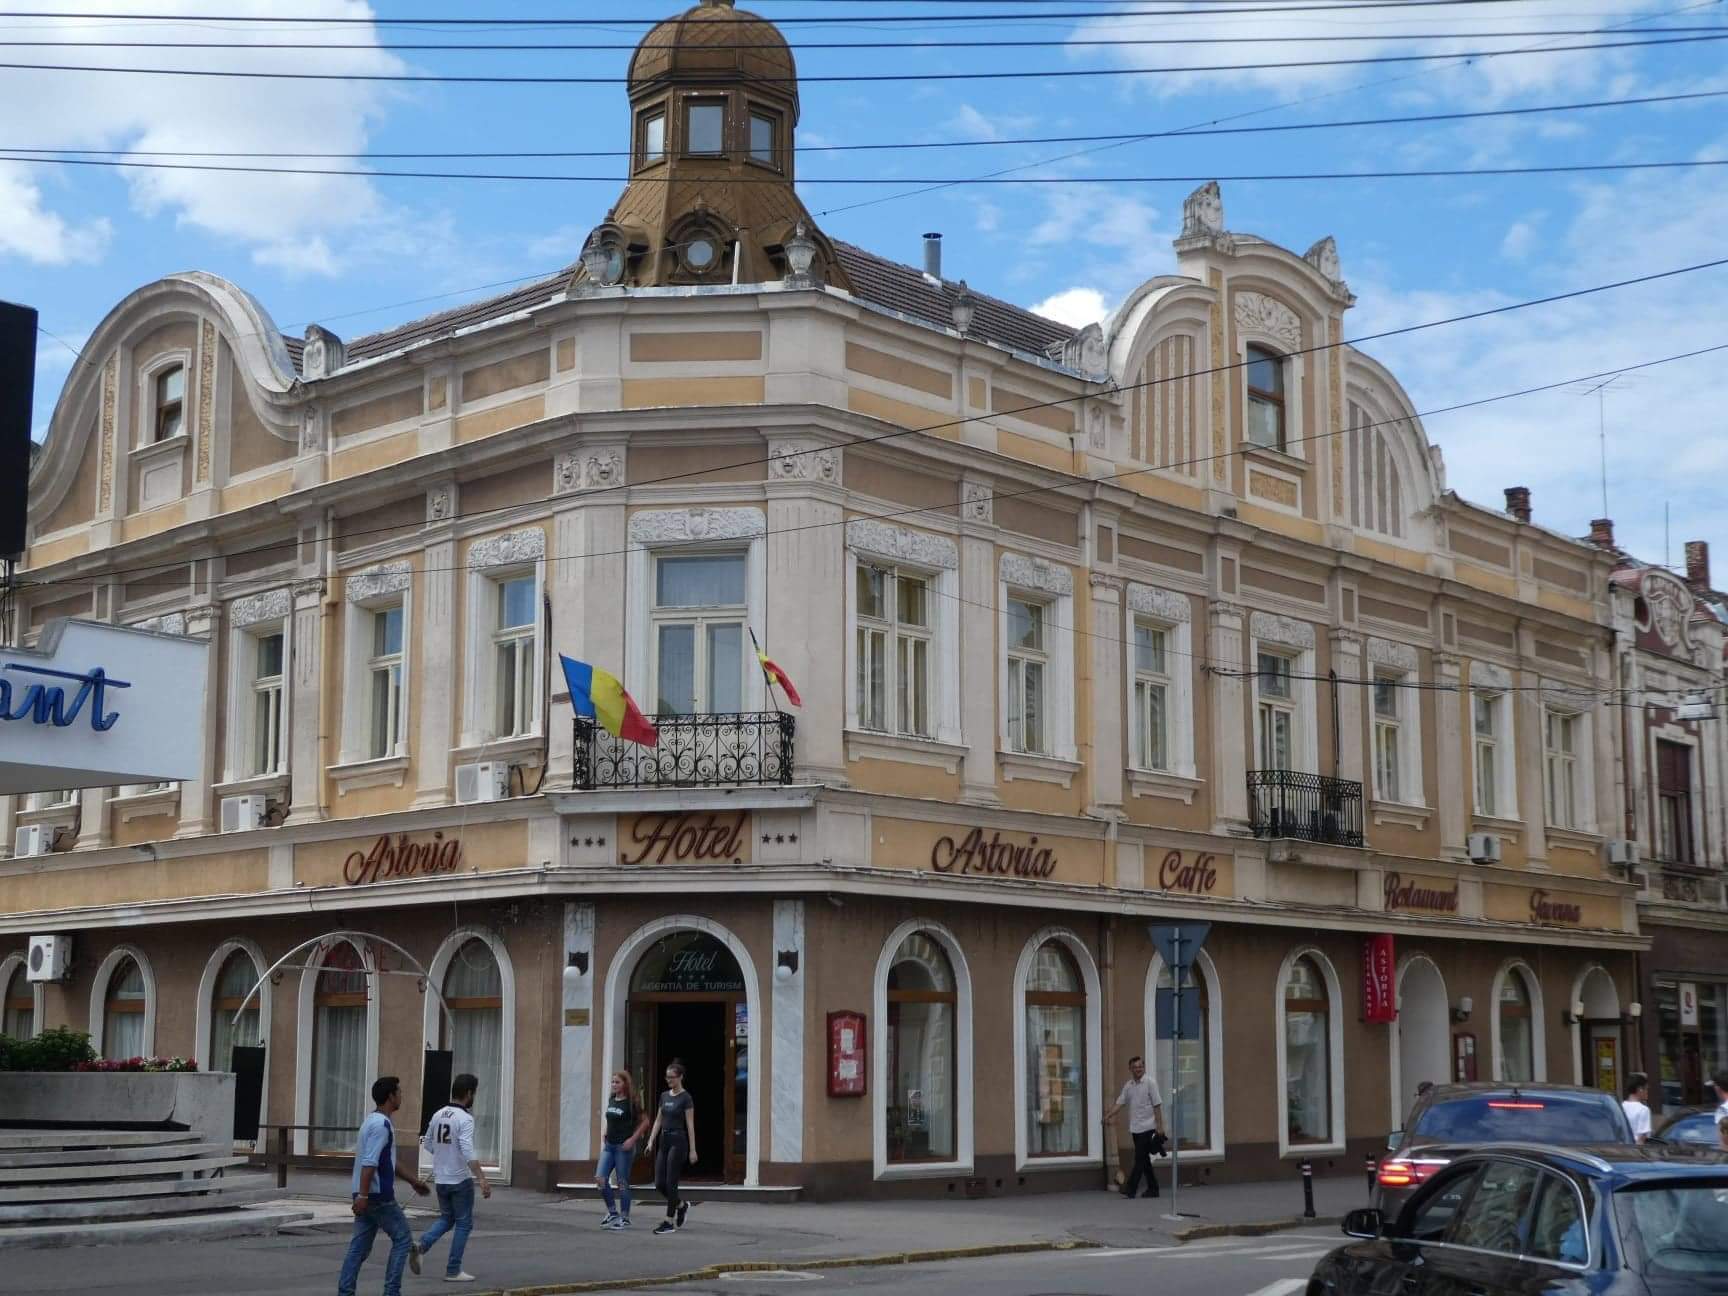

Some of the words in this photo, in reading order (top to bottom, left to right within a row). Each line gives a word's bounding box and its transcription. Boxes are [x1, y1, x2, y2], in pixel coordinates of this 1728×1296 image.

[343, 831, 462, 886] Astoria
[621, 810, 743, 865] Hotel
[932, 826, 1057, 877] Astoria
[1159, 850, 1216, 893] Caffe
[1384, 871, 1459, 912] Restaurant
[669, 951, 719, 973] Hotel
[1380, 948, 1389, 1008] ASTORIA
[686, 981, 700, 991] DE
[437, 1123, 452, 1144] 12
